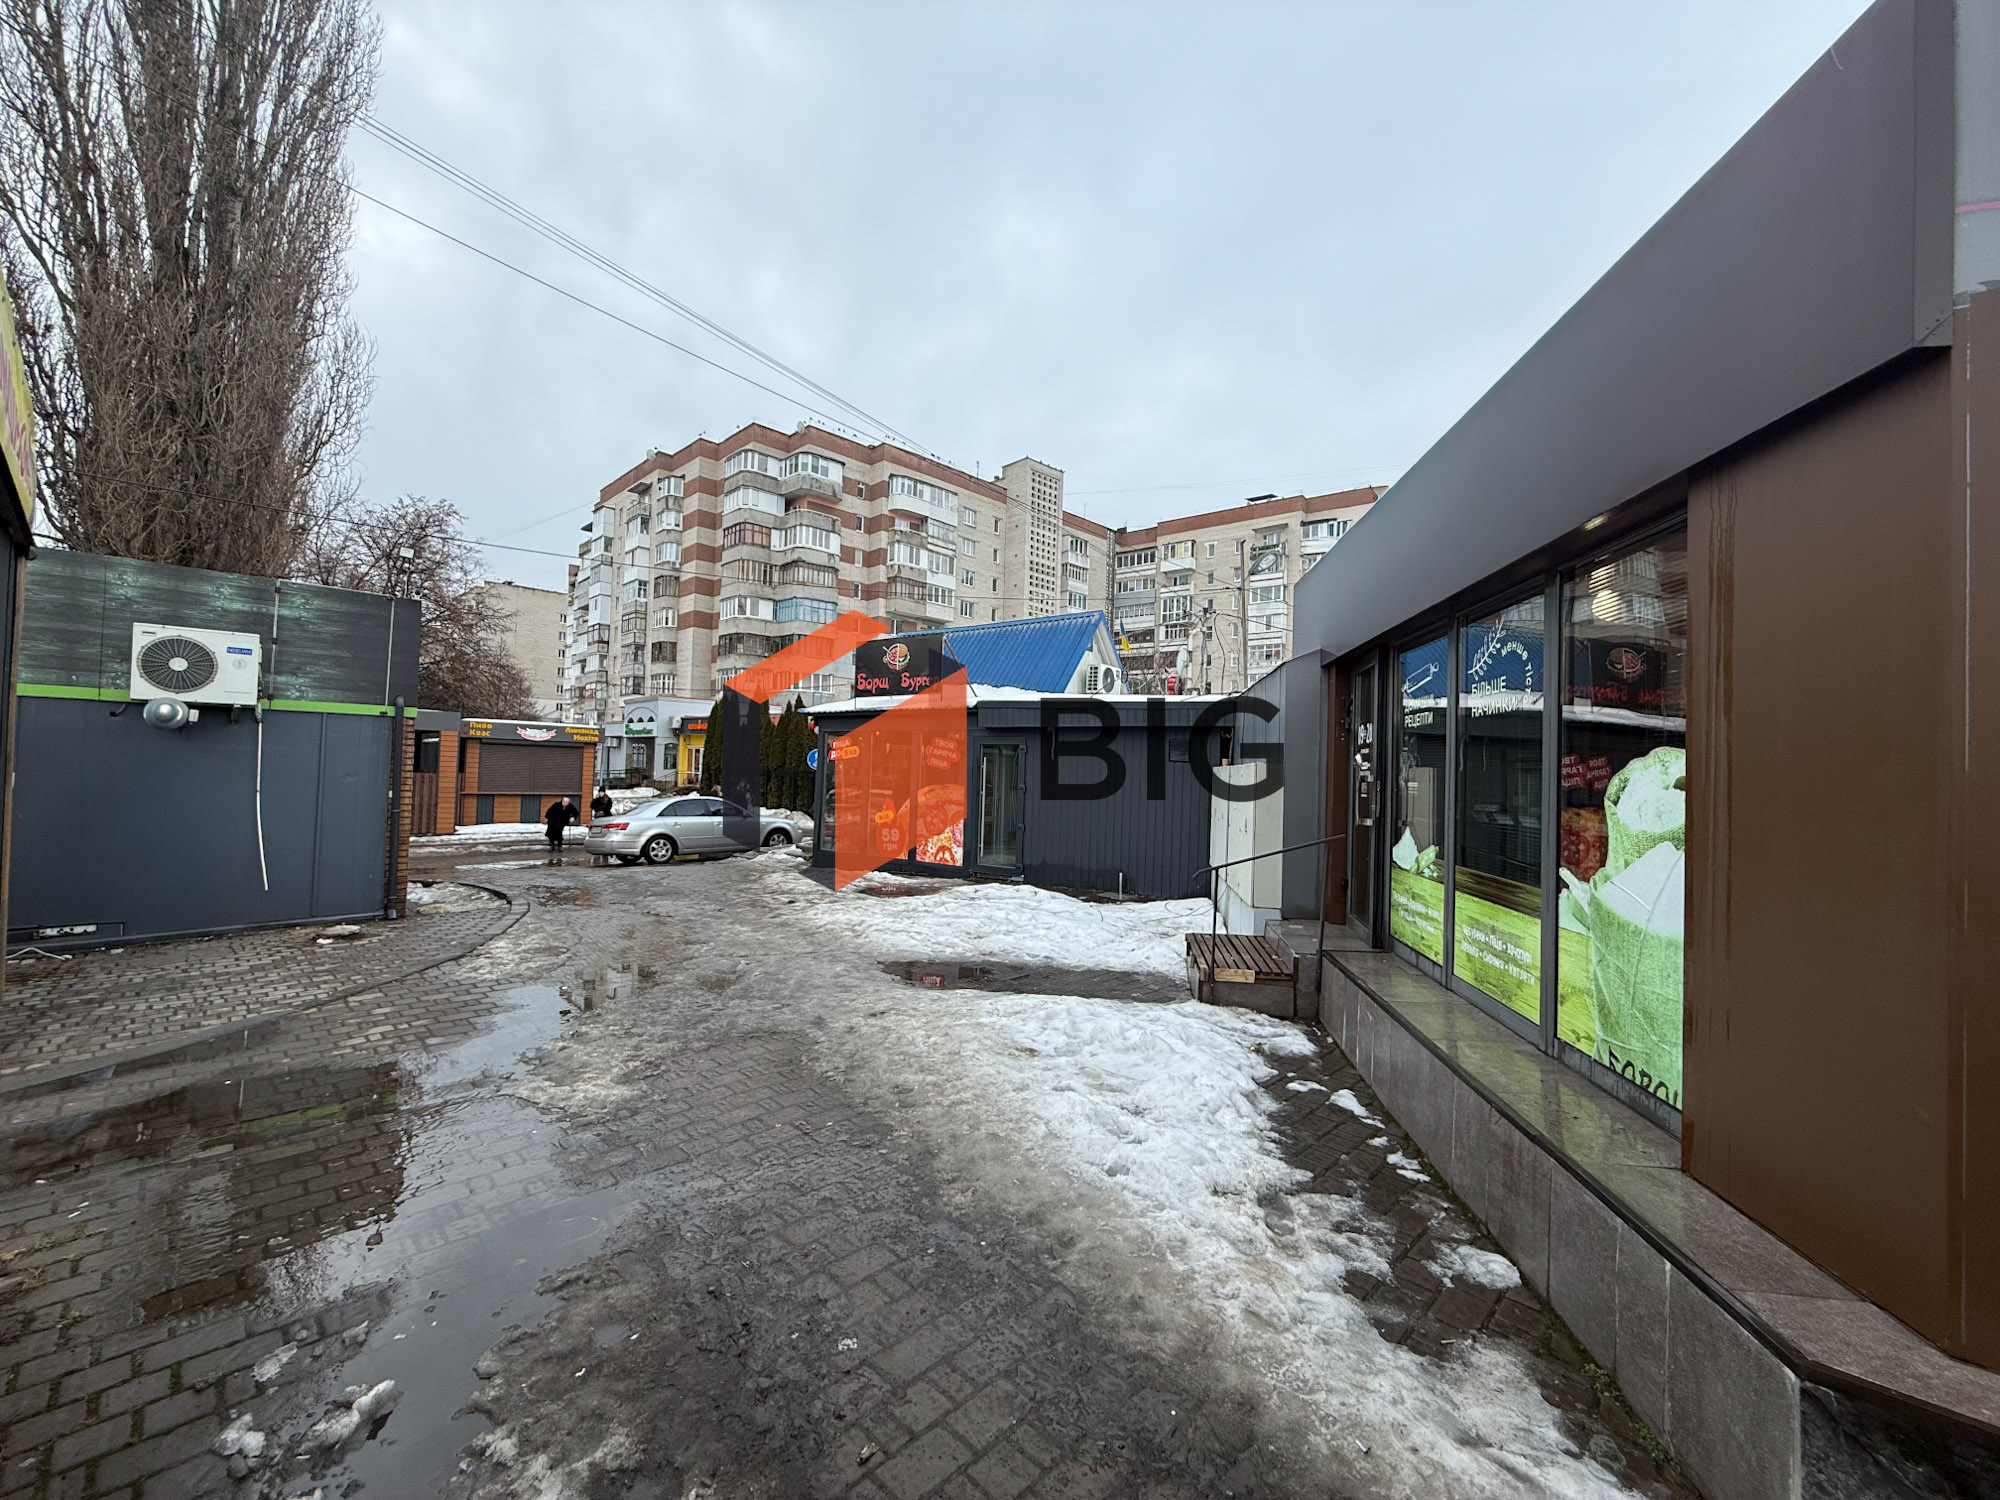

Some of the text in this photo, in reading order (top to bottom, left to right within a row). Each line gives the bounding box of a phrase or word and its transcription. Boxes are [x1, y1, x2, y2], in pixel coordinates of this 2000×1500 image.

[1501, 640, 1529, 661] менше
[857, 672, 890, 694] Борщ
[1471, 675, 1507, 698] БІЛЬШЕ
[1404, 711, 1434, 728] РЕЦЕПТИ
[469, 721, 493, 729] Пиво
[469, 729, 491, 737] Квас
[832, 739, 850, 749] ПІЦА
[935, 739, 954, 749] ТВОЯ
[831, 750, 841, 759] ДО
[929, 747, 957, 759] ГАРЯЧА
[930, 757, 948, 767] ПІЦА
[881, 828, 900, 842] 59
[883, 843, 898, 852] грн
